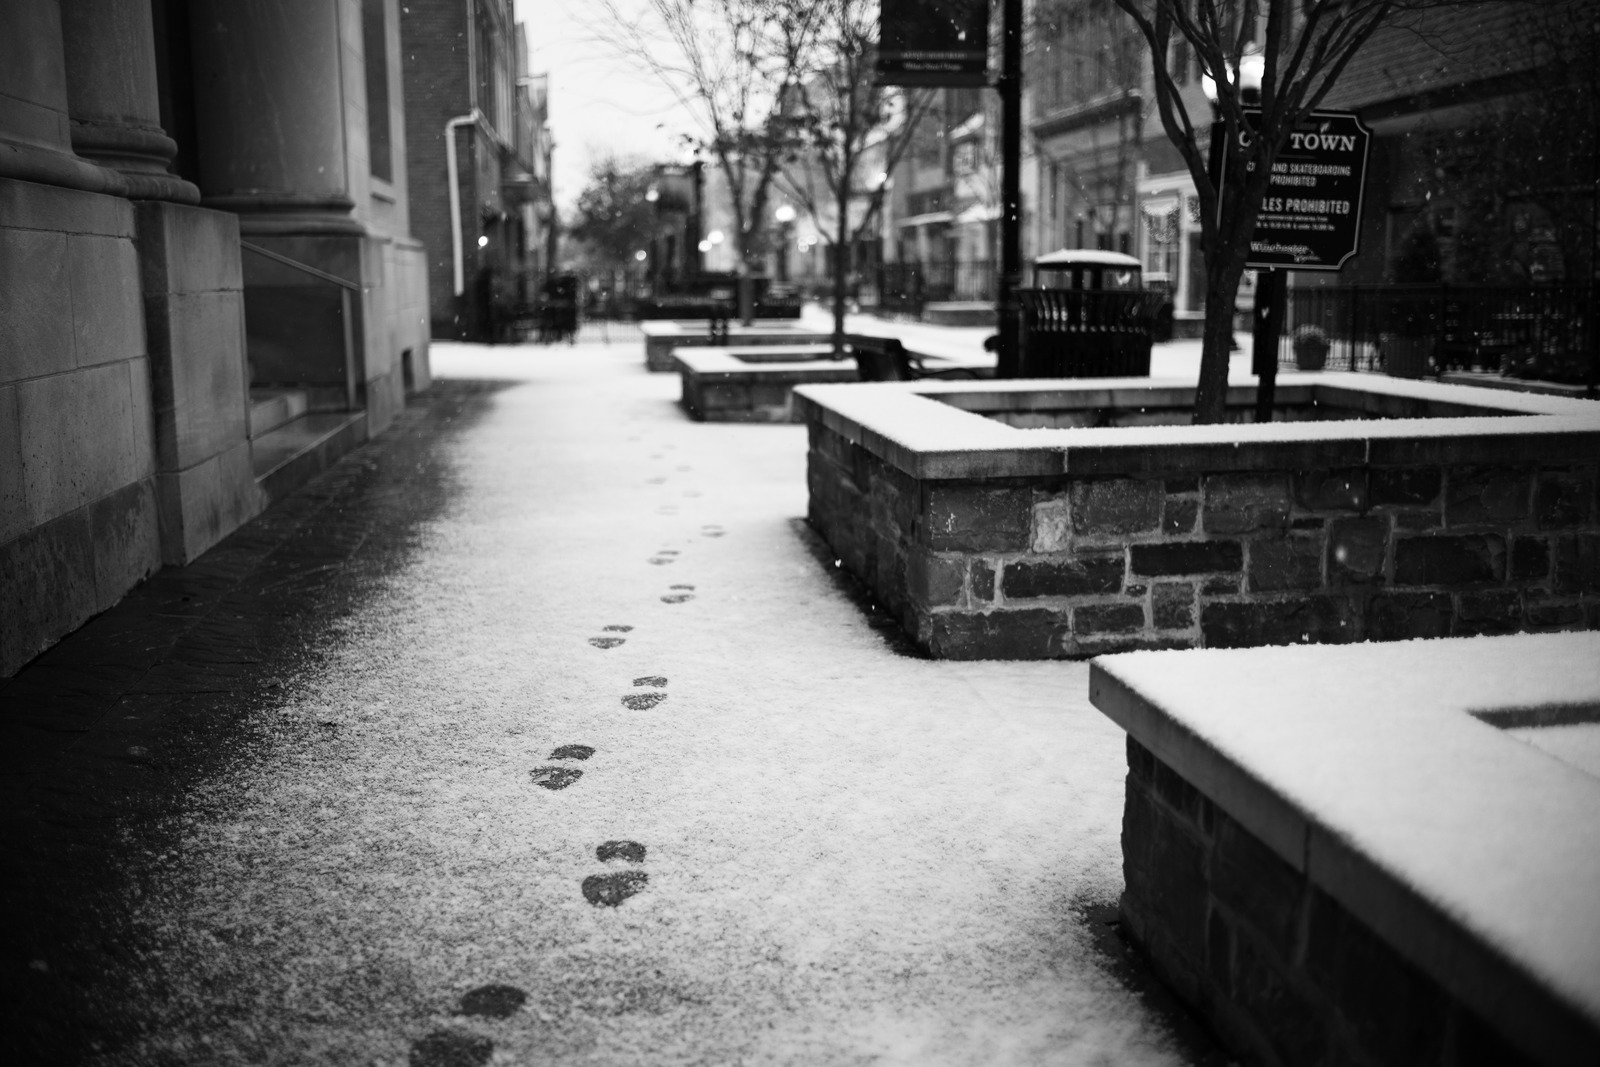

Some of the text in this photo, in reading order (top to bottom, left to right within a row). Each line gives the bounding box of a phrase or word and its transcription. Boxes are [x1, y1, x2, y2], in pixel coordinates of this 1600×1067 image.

[1290, 132, 1356, 151] TOWN
[1271, 162, 1351, 176] AND SKATEBOARDING
[1270, 174, 1317, 187] PROHIBITED
[1285, 198, 1350, 214] PROHIBITED
